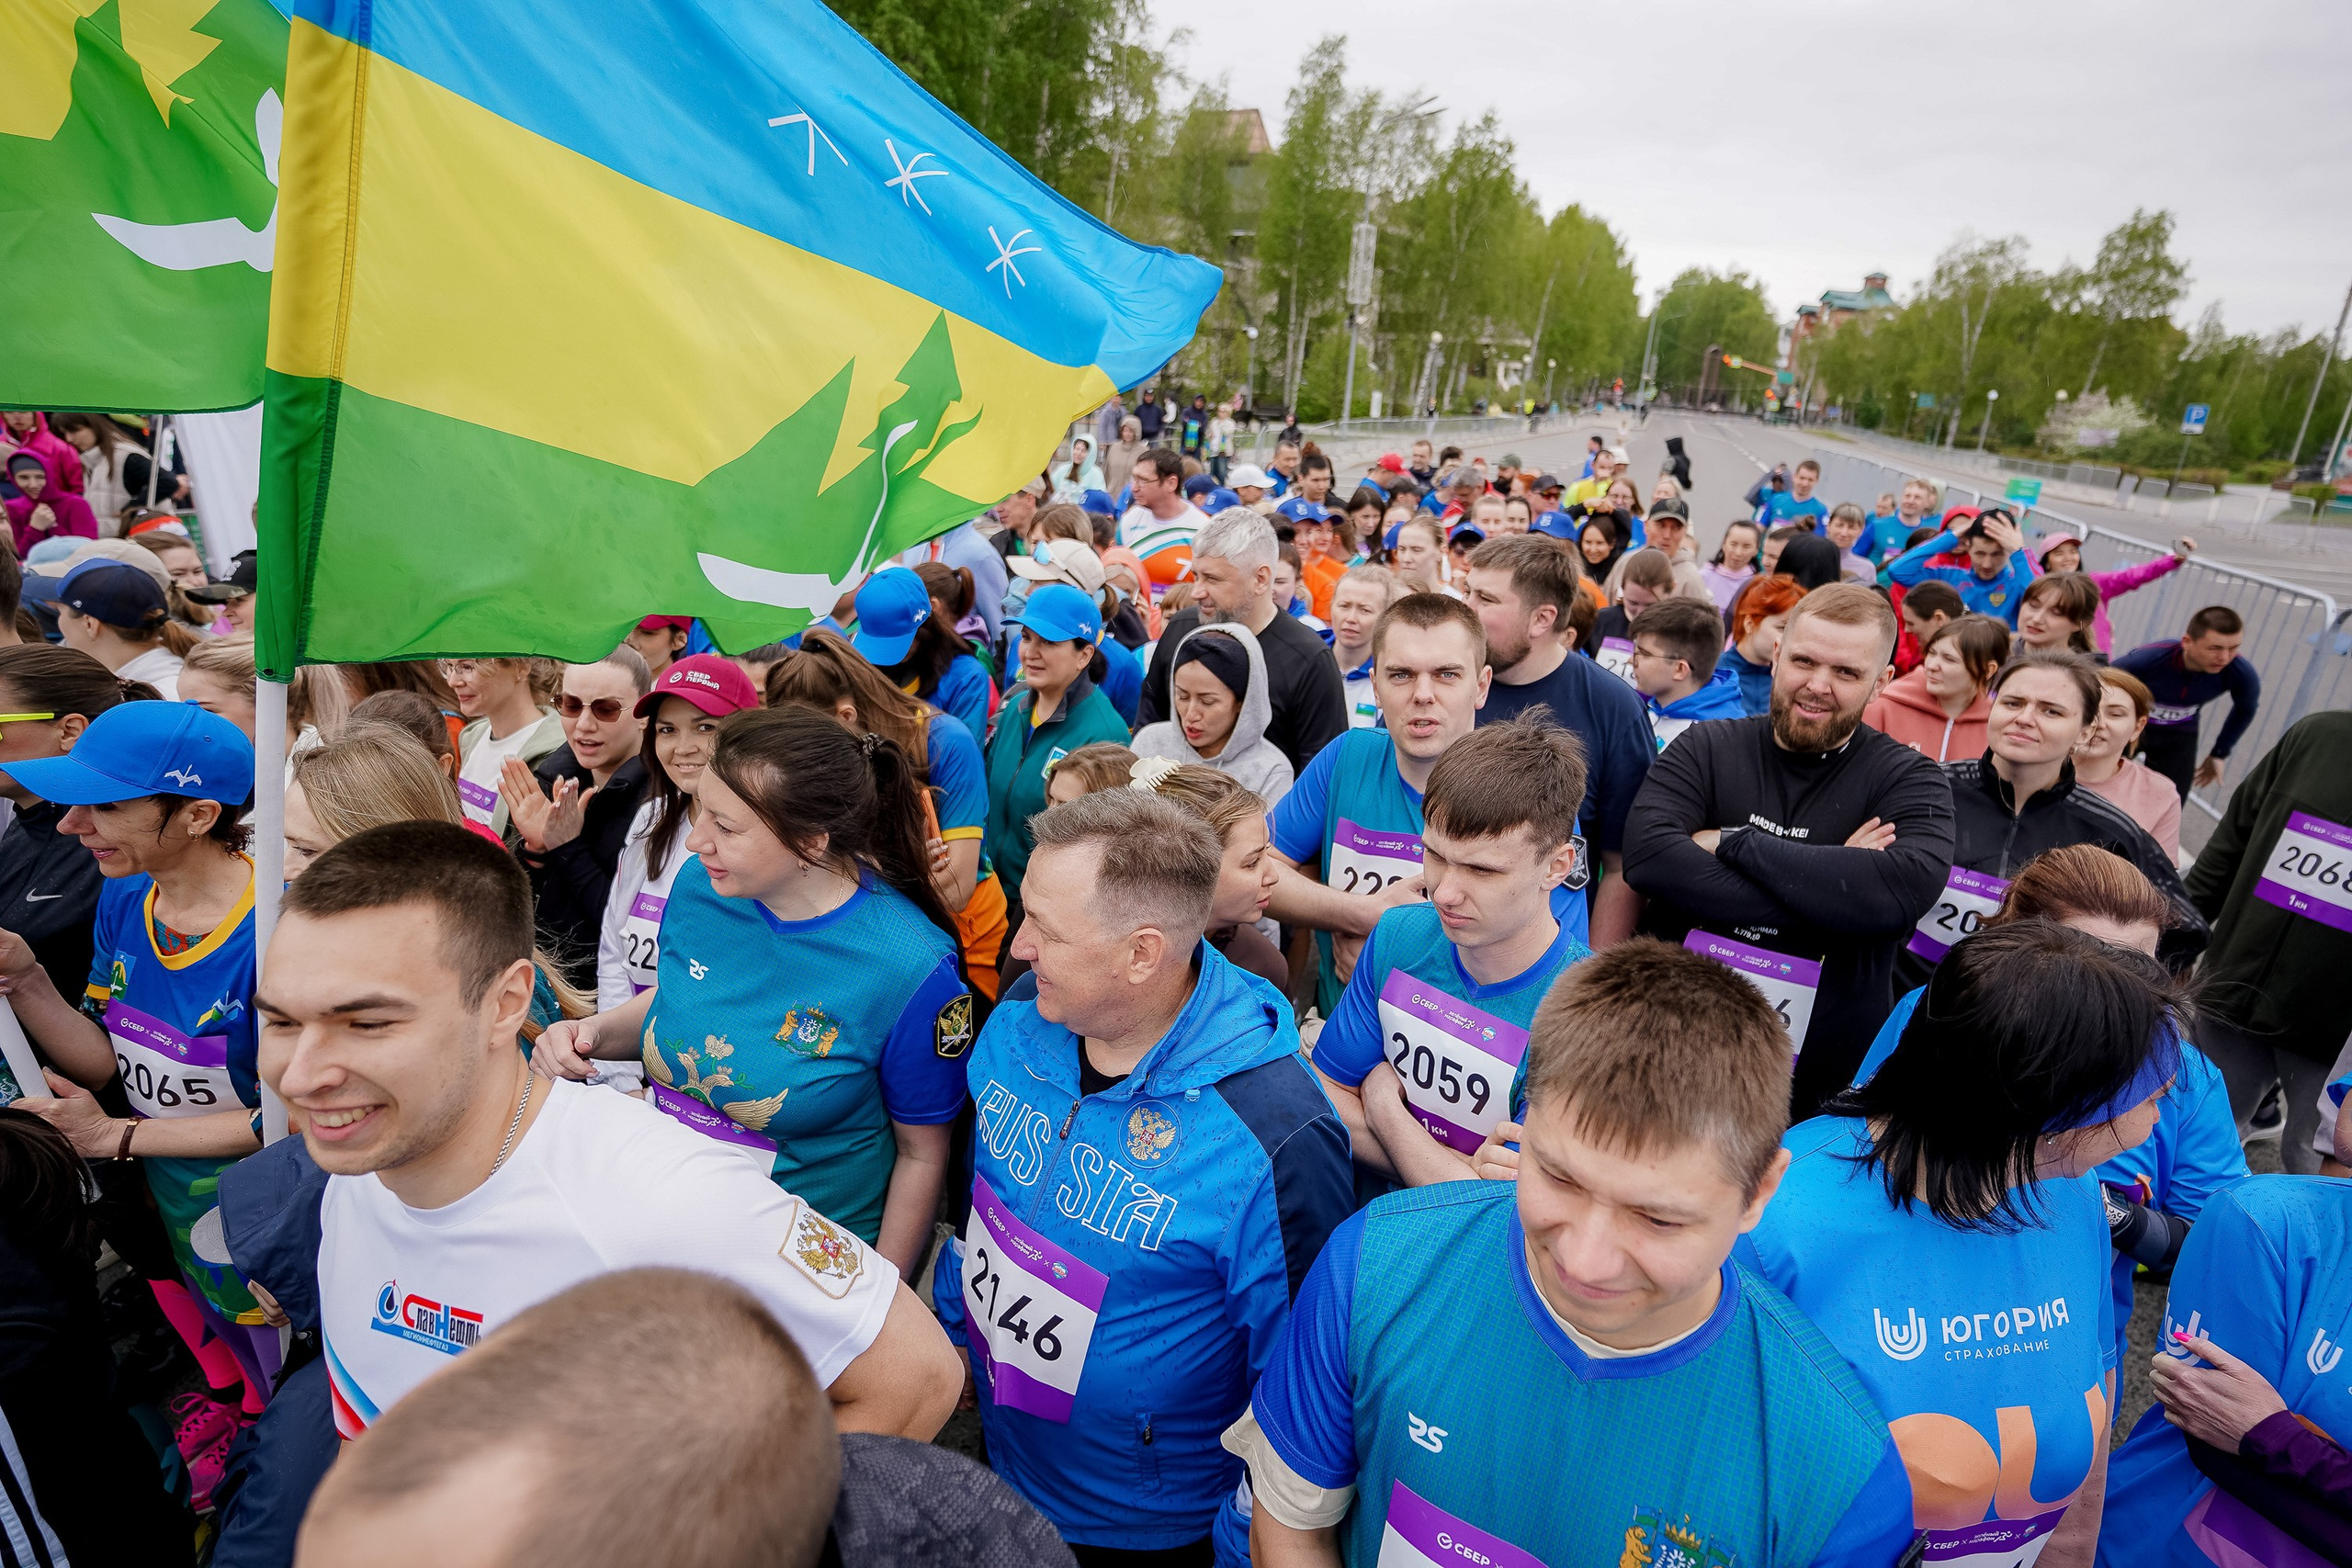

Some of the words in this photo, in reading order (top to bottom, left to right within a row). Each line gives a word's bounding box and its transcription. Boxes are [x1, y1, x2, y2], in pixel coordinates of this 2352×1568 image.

[2190, 406, 2205, 423] P
[685, 676, 720, 690] ПЕРВЫЙ
[687, 671, 711, 680] СБЕР
[1748, 814, 1776, 833] MADE
[1419, 998, 1439, 1011] СБЕР
[128, 1021, 145, 1032] СБЕР
[117, 1053, 218, 1107] 2065
[1392, 1032, 1491, 1116] 2059
[664, 1100, 681, 1112] СБЕР
[992, 1214, 1006, 1232] СБЕР
[970, 1247, 1065, 1361] 2146
[1940, 1297, 2070, 1345] ЮГОРИЯ
[1944, 1338, 2050, 1361] СТРАХОВАНИЕ
[1454, 1542, 1491, 1566] СБЕР
[1932, 1540, 1960, 1550] СБЕР
